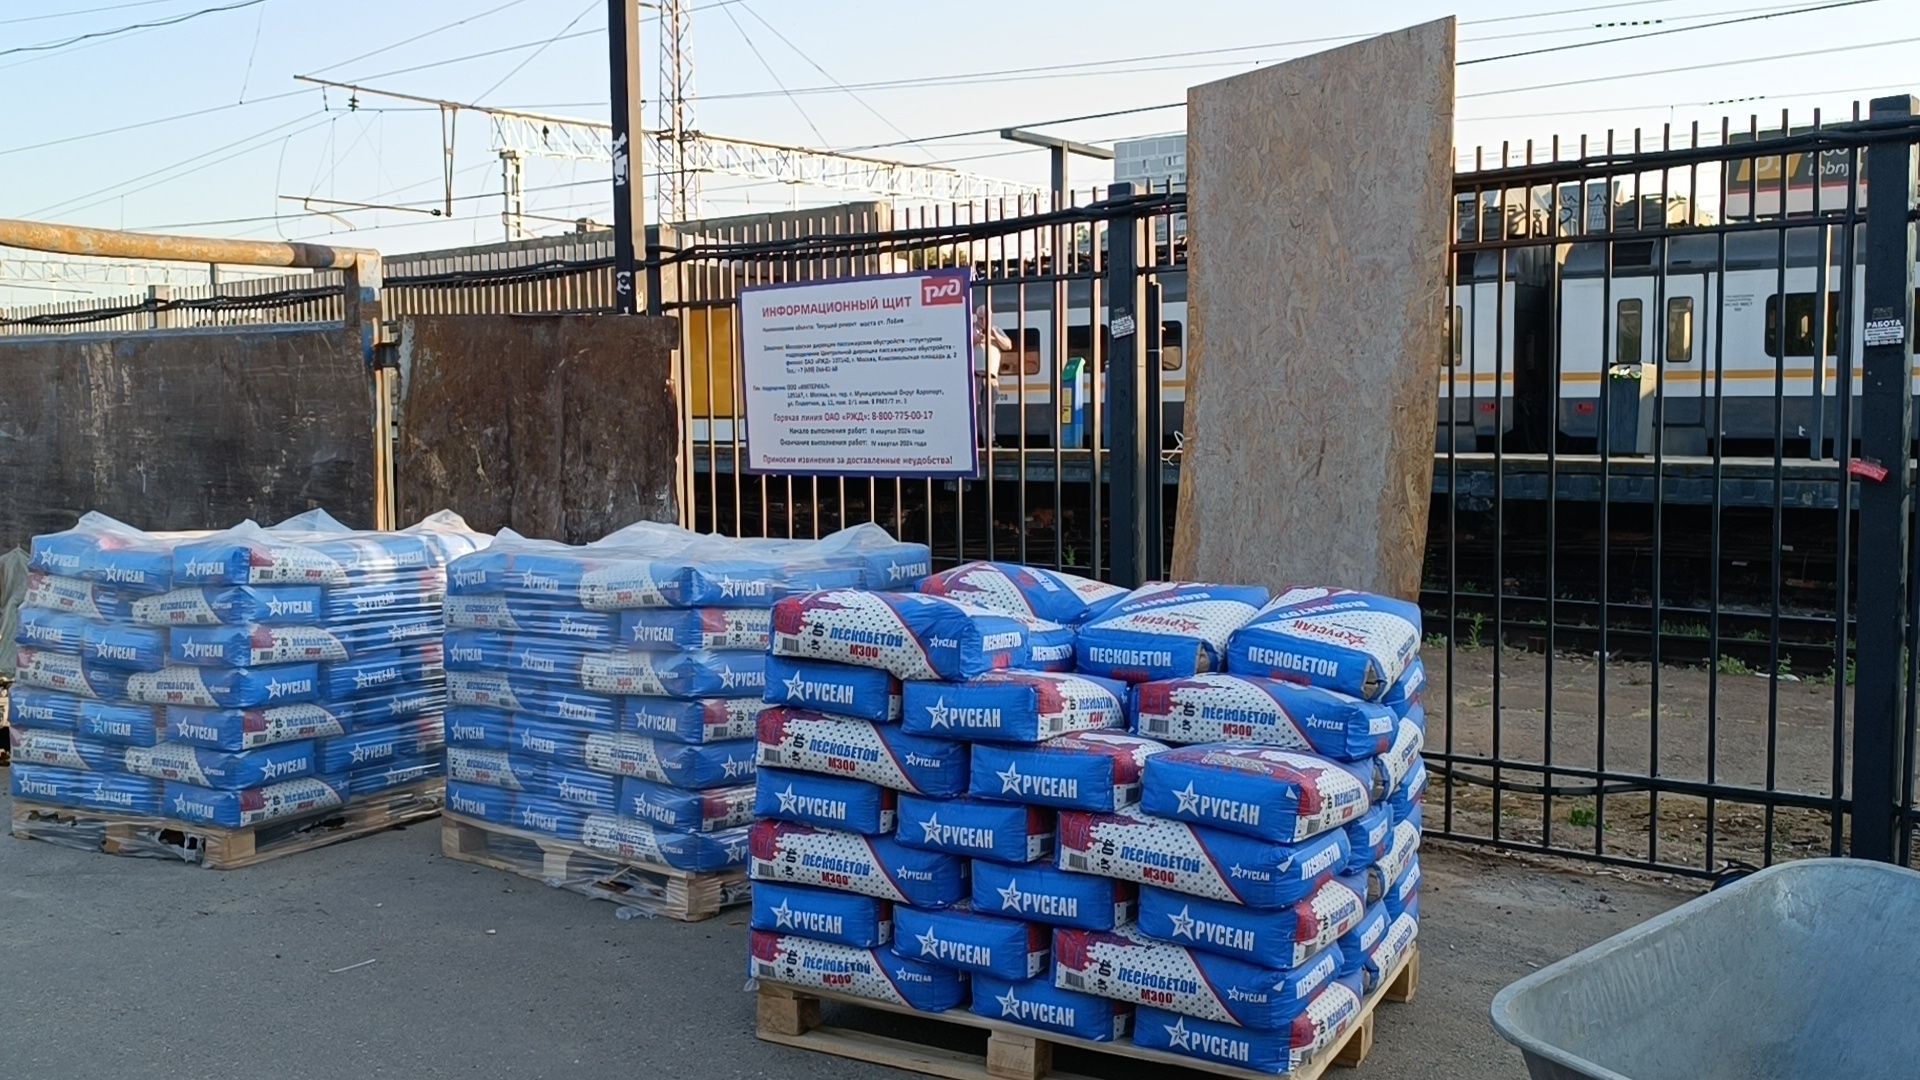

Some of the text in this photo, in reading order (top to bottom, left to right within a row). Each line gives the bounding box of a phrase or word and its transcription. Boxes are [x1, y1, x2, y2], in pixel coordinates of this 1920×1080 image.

[762, 296, 912, 318] ИНФОРМАЦИОННЫЙ ЩИТ
[1866, 319, 1902, 328] РАБОТА
[774, 413, 799, 423] Горячая
[824, 412, 840, 421] ОАО
[872, 410, 934, 420] 8-800-775-00-17
[763, 454, 796, 465] Приносим
[798, 456, 835, 464] извинения
[846, 456, 901, 465] доставленные
[903, 455, 953, 466] неудобства!
[734, 581, 766, 597] РУСЕАН
[282, 600, 313, 614] РУСЕАН
[829, 627, 904, 648] ПЕСКОБЕТОН
[850, 644, 879, 658] М300
[1089, 646, 1172, 667] ПЕСКОБЕТОН
[1248, 646, 1339, 678] ПЕСКОБЕТОН
[281, 679, 312, 696] РУСЕАН
[806, 682, 854, 704] РУСЕАН
[647, 716, 677, 732] РУСЕАН
[949, 707, 1001, 728] РУСЕАН
[1201, 706, 1277, 726] ПЕСКОБЕТОН
[189, 724, 218, 741] РУСЕАН
[1222, 724, 1253, 737] М300
[809, 738, 880, 762] ПЕСКОБЕТОН
[276, 757, 307, 776] РУСЕАН
[828, 757, 856, 772] М300
[1022, 774, 1078, 799] РУСЕАН
[798, 796, 847, 820] РУСЕАН
[1200, 795, 1261, 826] РУСЕАН
[942, 826, 994, 849] РУСЕАН
[802, 853, 871, 876] ПЕСКОБЕТОН
[1120, 846, 1201, 874] ПЕСКОБЕТОН
[821, 871, 849, 886] М300
[1143, 866, 1175, 883] М300
[1022, 892, 1078, 918] РУСЕАН
[793, 912, 843, 935] РУСЕАН
[1195, 920, 1255, 952] РУСЕАН
[939, 938, 991, 967] РУСЕАН
[803, 954, 871, 975] ПЕСКОБЕТОН
[822, 972, 852, 985] М300
[1117, 966, 1198, 995] ПЕСКОБЕТОН
[1140, 988, 1173, 1005] М300
[1021, 1000, 1075, 1028] РУСЕАН
[1191, 1031, 1250, 1062] РУСЕАН
